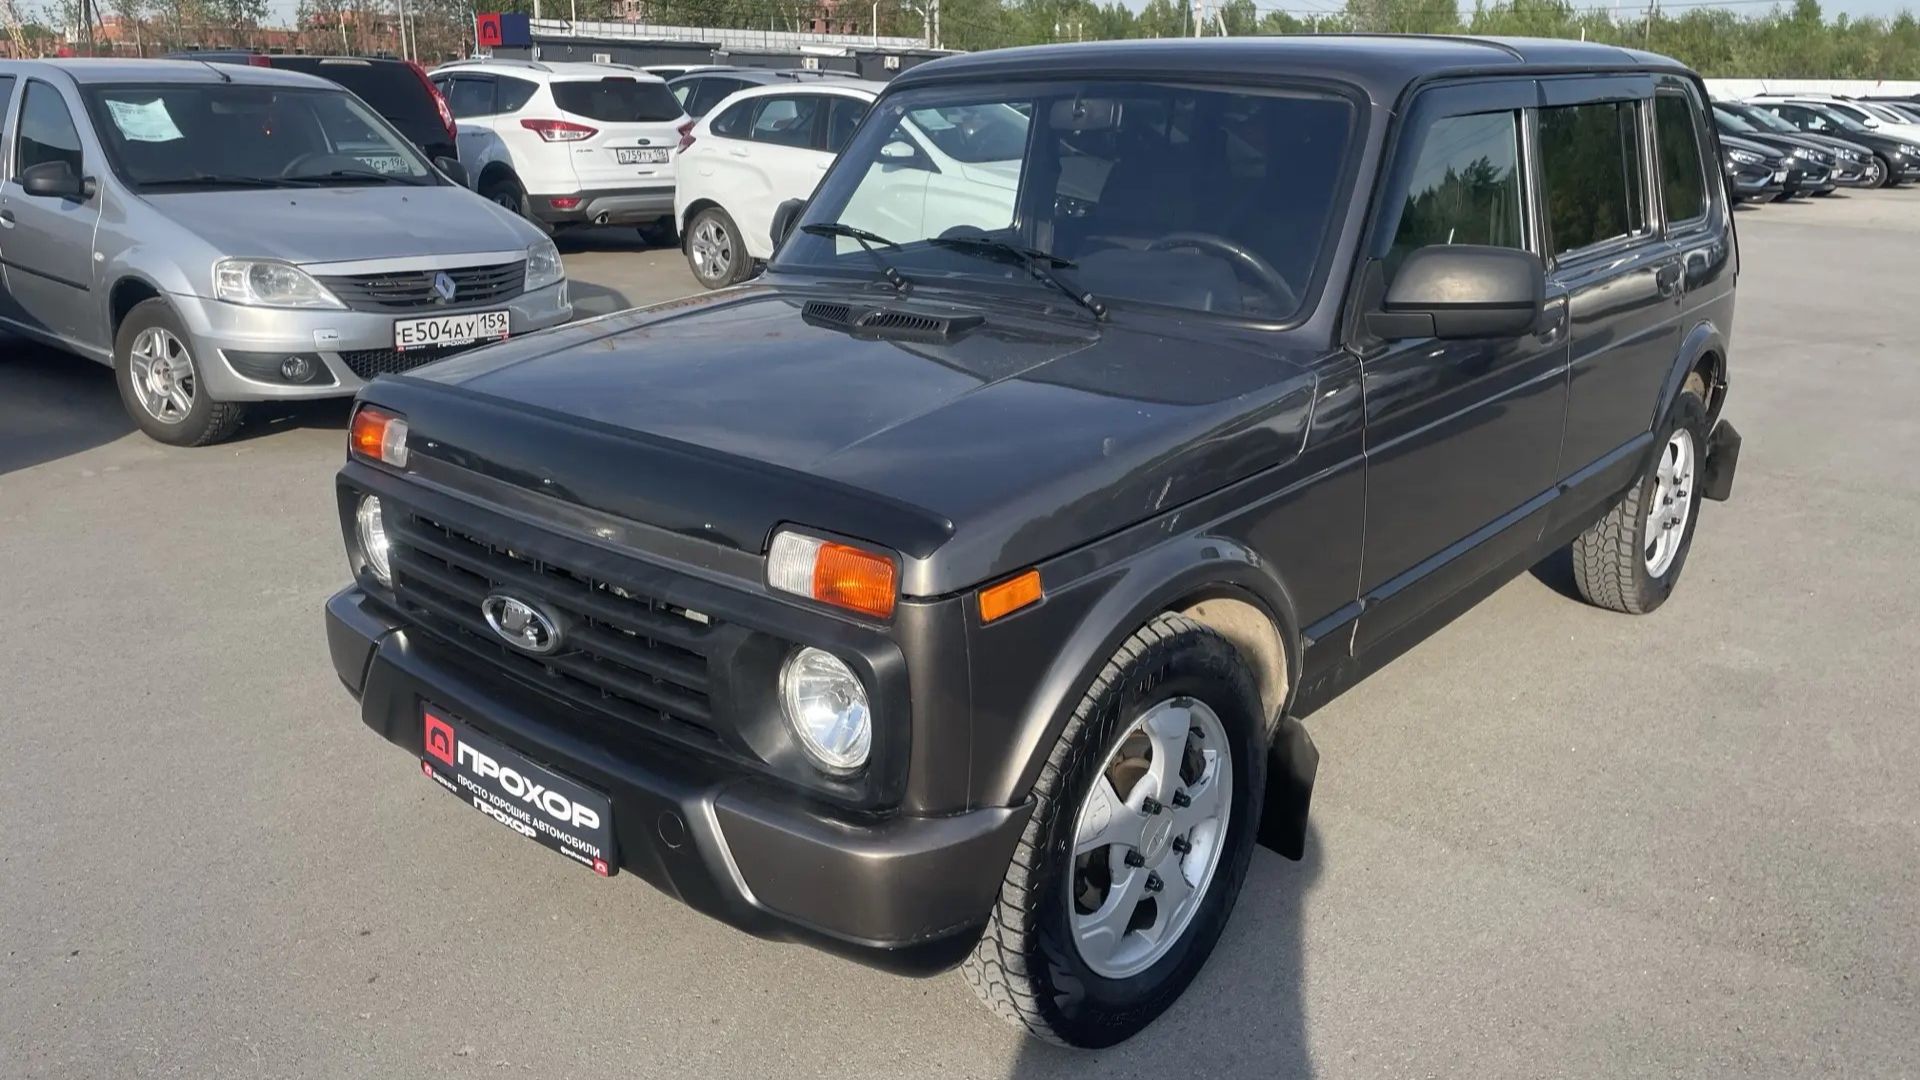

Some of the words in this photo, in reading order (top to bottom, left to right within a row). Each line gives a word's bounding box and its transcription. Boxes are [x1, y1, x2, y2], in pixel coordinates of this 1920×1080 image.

[402, 320, 475, 343] Е504АУ
[480, 313, 505, 329] 159
[457, 740, 600, 830] ПРОХОР
[457, 773, 488, 800] ПРОСТО
[489, 790, 531, 825] ХОРОШИЕ
[532, 815, 600, 858] АВТОМОБИЛИ
[473, 797, 537, 838] ПРОХОР
